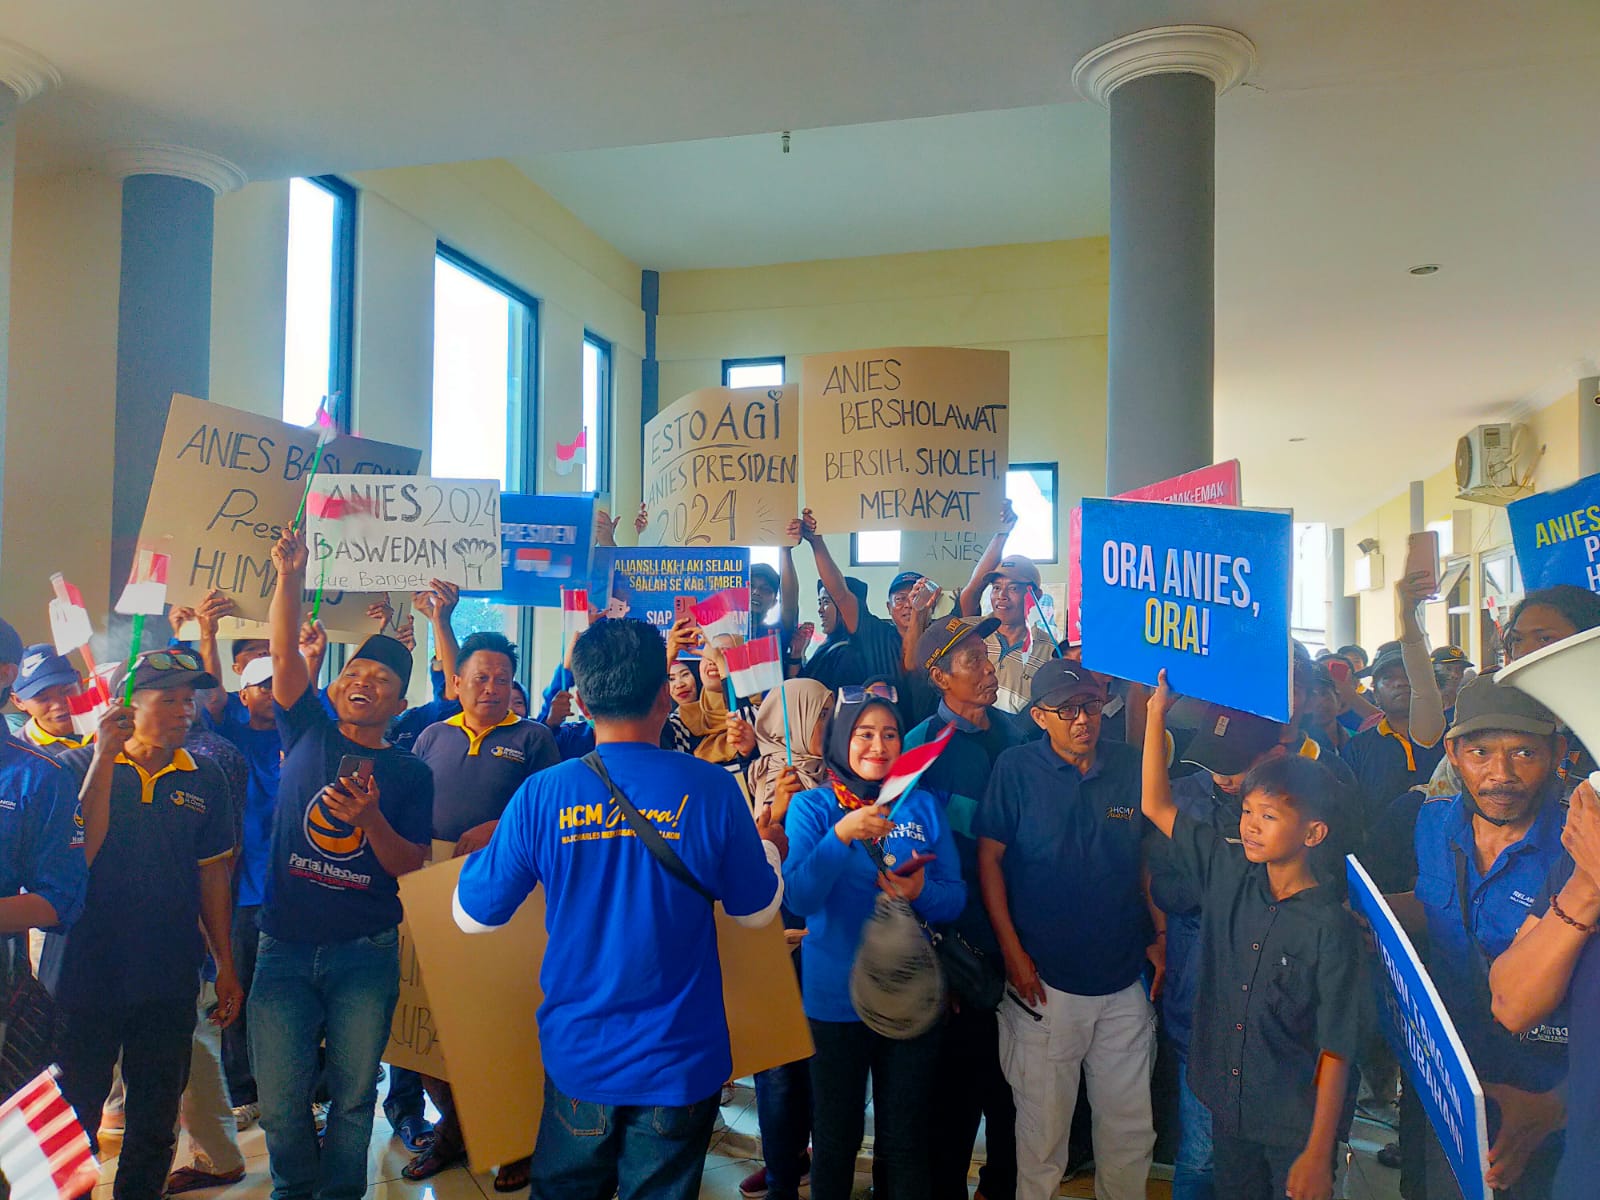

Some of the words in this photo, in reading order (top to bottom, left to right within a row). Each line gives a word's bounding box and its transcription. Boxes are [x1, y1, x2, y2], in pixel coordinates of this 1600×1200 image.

[823, 358, 902, 396] ANIES
[840, 398, 1007, 434] BERSHOLAWAT
[176, 424, 276, 474] ANIES
[648, 464, 688, 511] ANIES
[692, 452, 797, 488] PRESIDEN
[318, 483, 422, 522] ANIES
[423, 484, 497, 537] 2024
[656, 489, 737, 546] 2024
[860, 488, 981, 522] MERAKYAT
[313, 531, 448, 571] BASWEDAN
[705, 560, 743, 573] SELALU
[926, 544, 983, 564] ANIES
[359, 571, 428, 590] Banget
[669, 578, 681, 591] SE
[1102, 540, 1156, 593] ORA
[1163, 548, 1260, 618] ANIES,
[646, 609, 672, 625] SIAP
[1144, 597, 1210, 656] ORA!
[559, 803, 603, 830] HCM
[288, 852, 322, 871] Partai
[323, 862, 371, 885] NasDem
[1410, 993, 1463, 1128] TANGAN
